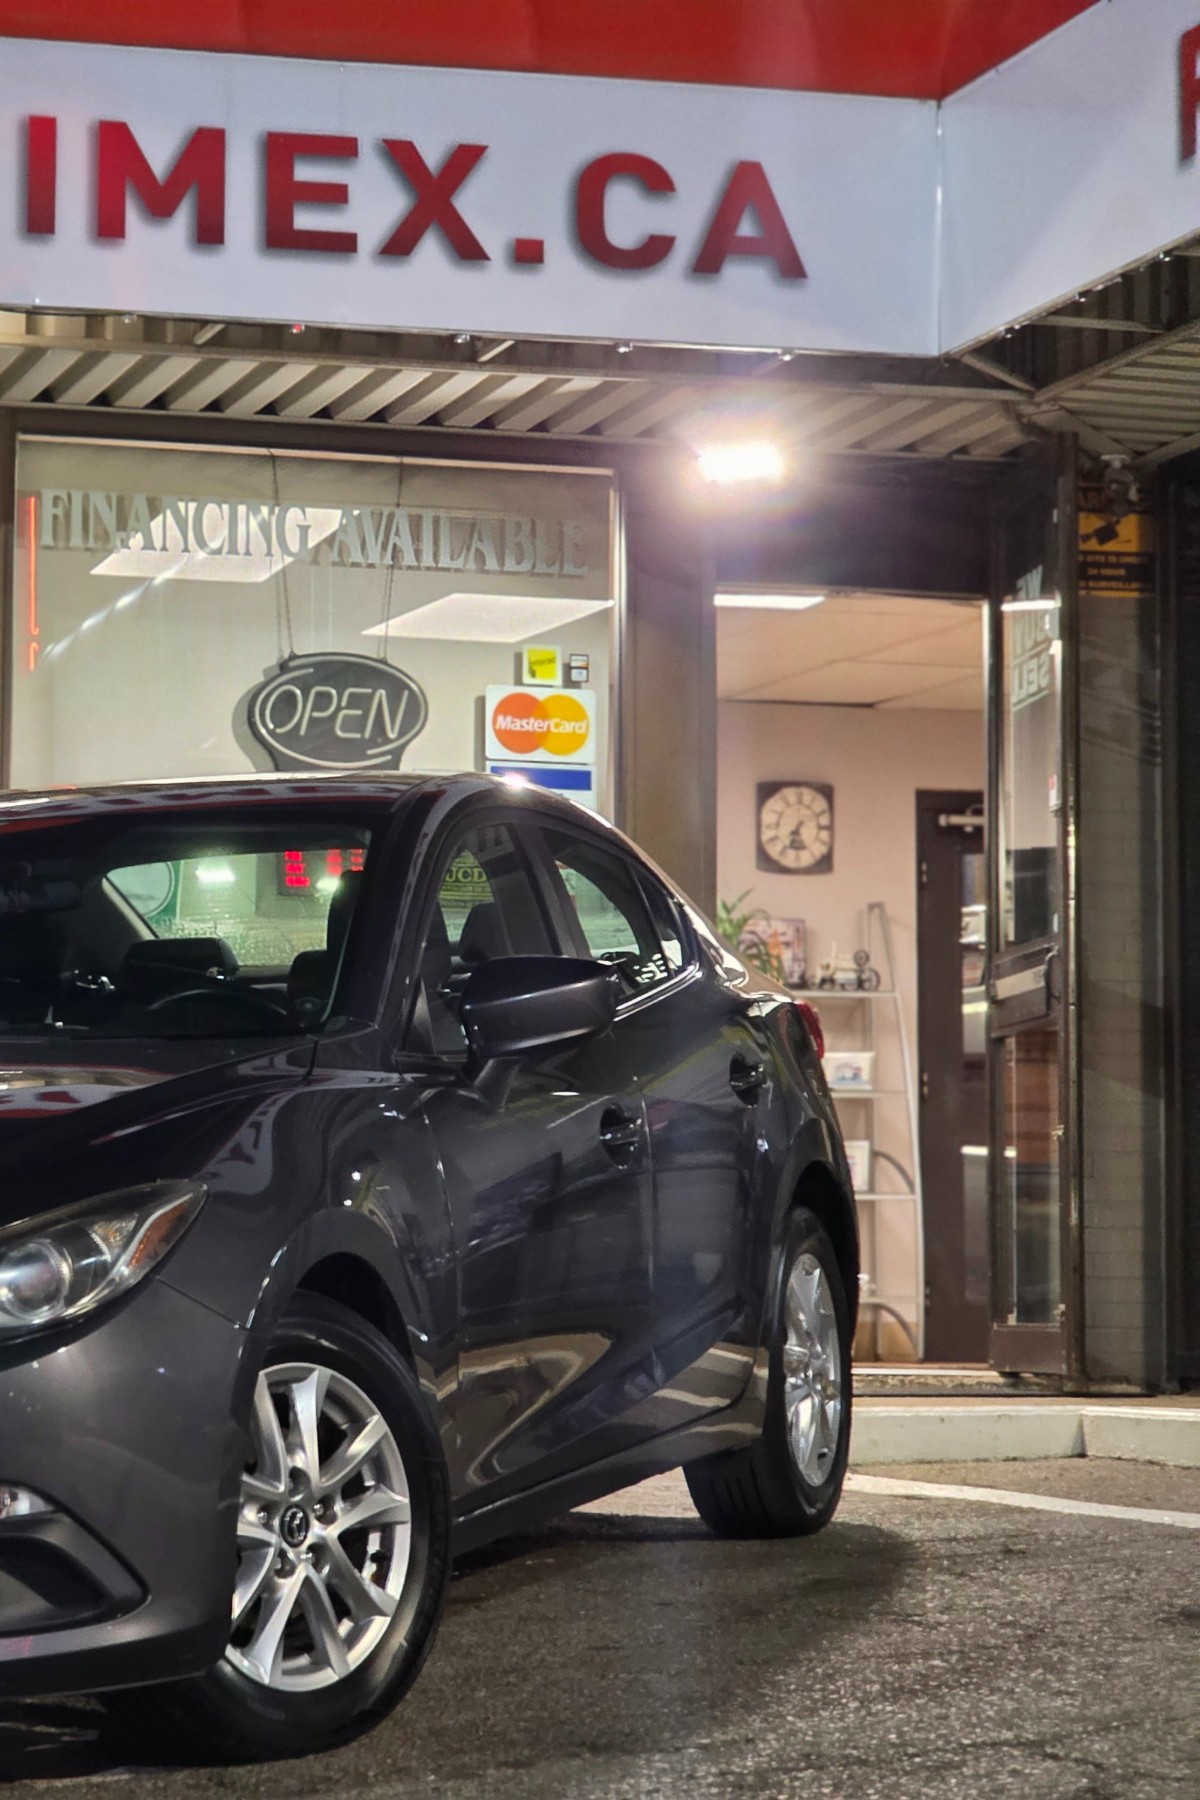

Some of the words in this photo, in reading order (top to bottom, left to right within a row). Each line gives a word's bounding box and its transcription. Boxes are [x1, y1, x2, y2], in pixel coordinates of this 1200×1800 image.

[39, 488, 311, 559] FINANCING
[330, 508, 589, 576] AVAILABLE
[263, 683, 409, 740] OPEN
[495, 714, 588, 734] MasterCard
